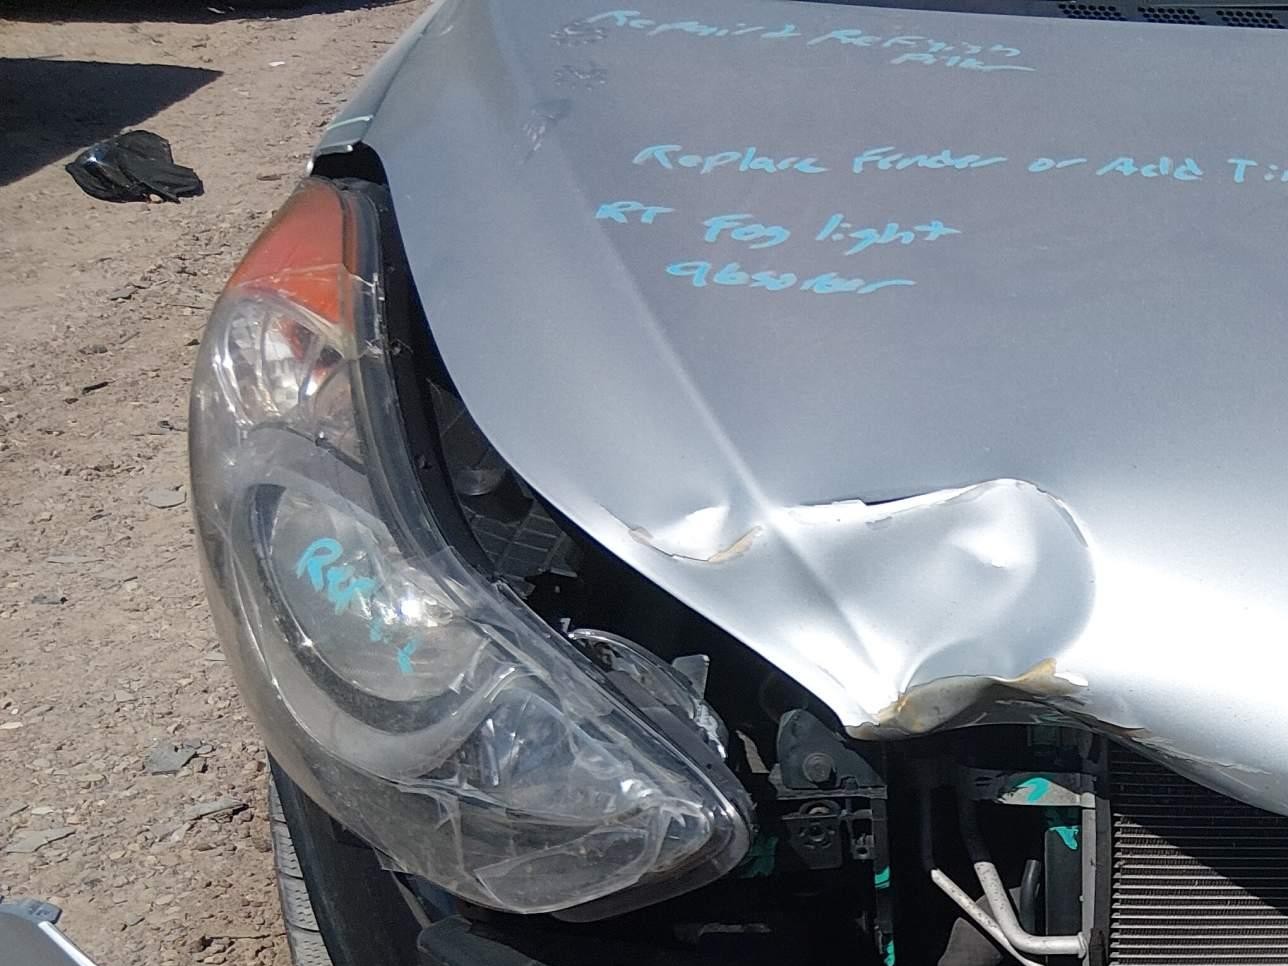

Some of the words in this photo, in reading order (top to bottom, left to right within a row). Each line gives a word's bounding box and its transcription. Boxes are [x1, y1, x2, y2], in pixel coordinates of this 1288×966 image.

[632, 144, 829, 174] Replace
[852, 145, 1009, 174] Fender
[1027, 157, 1088, 173] or
[1096, 156, 1204, 182] Add
[702, 213, 792, 250] Fog
[815, 212, 962, 257] light
